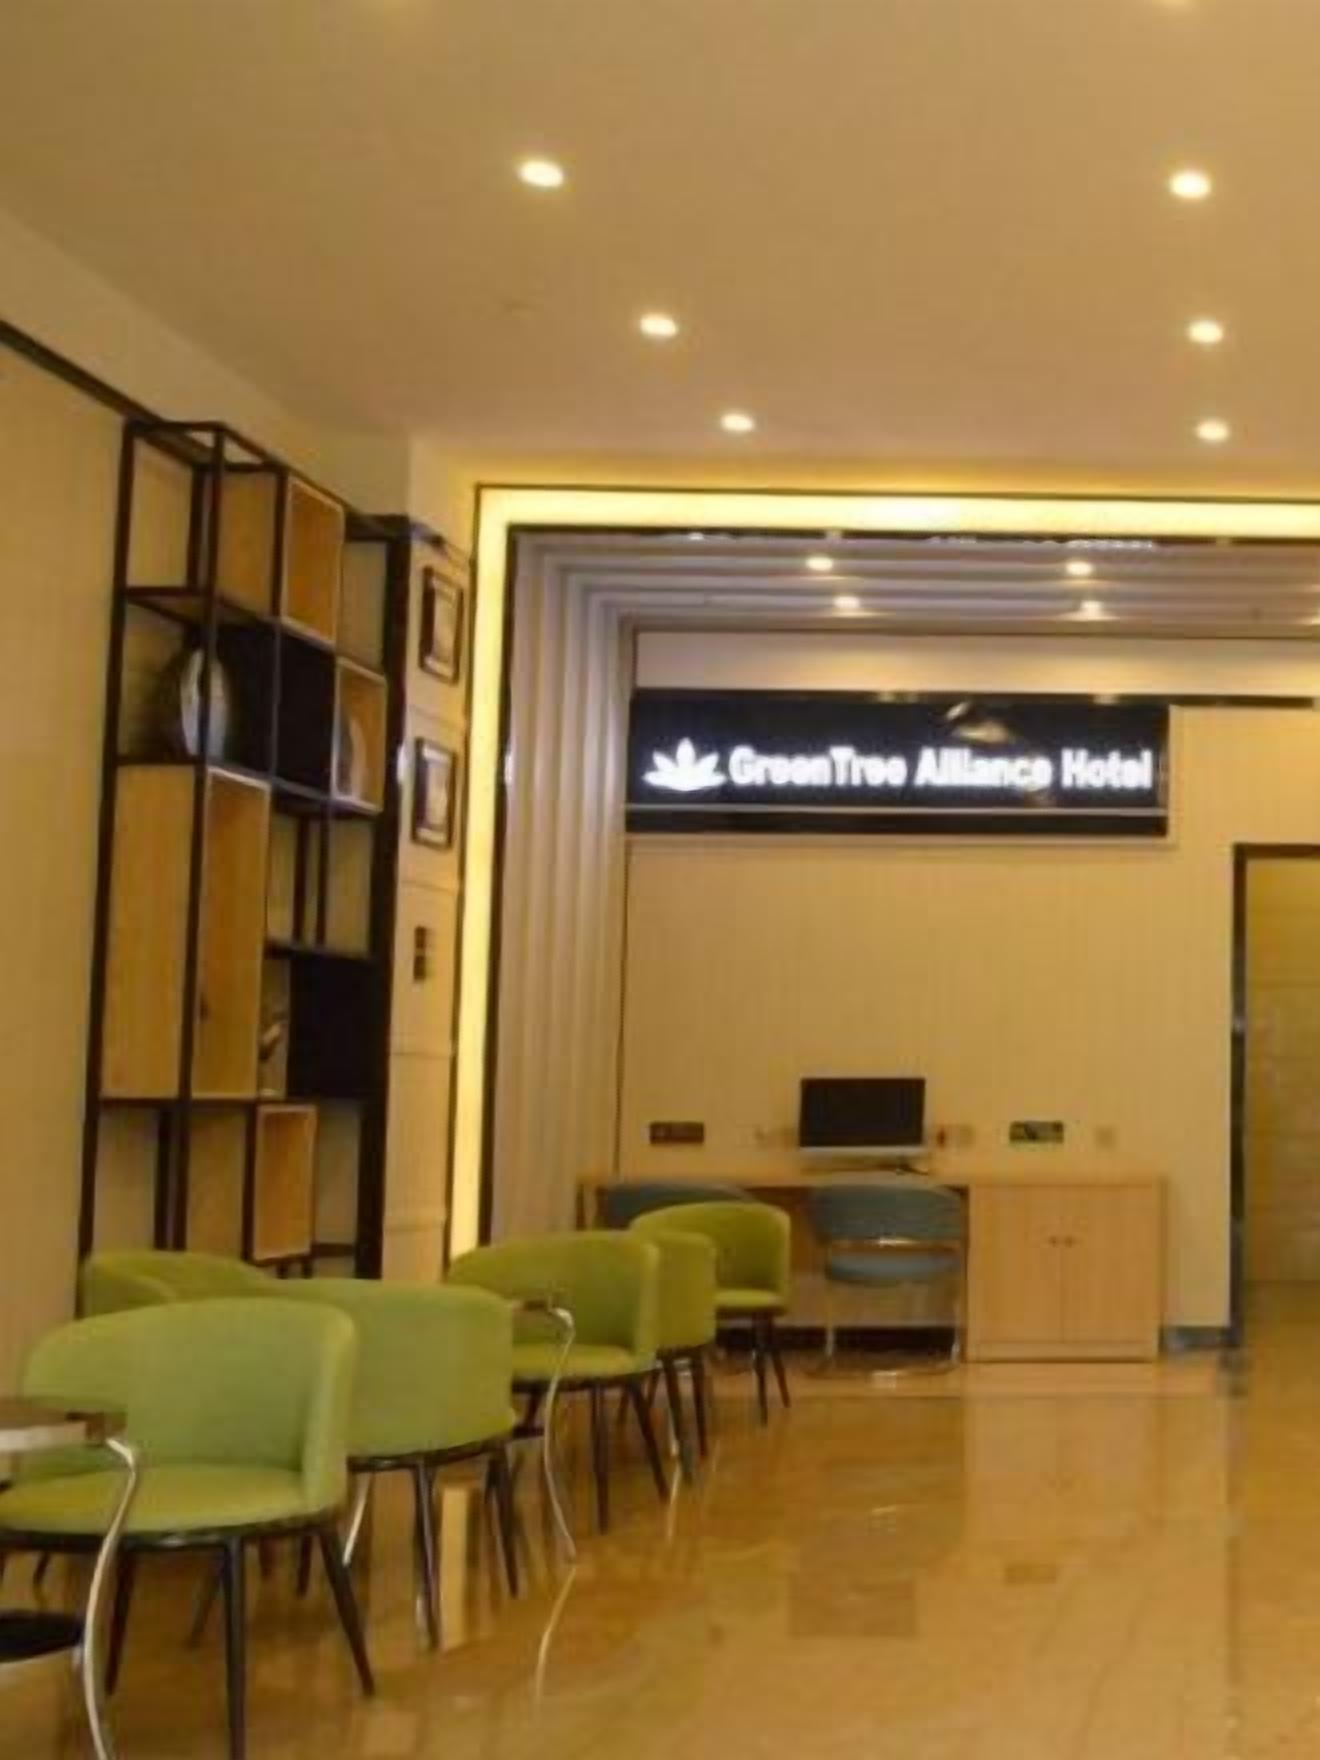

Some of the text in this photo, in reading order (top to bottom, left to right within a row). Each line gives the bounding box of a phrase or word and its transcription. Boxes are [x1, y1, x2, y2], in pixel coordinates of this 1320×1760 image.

[728, 745, 1153, 789] GreenTree Alliance Hotel
